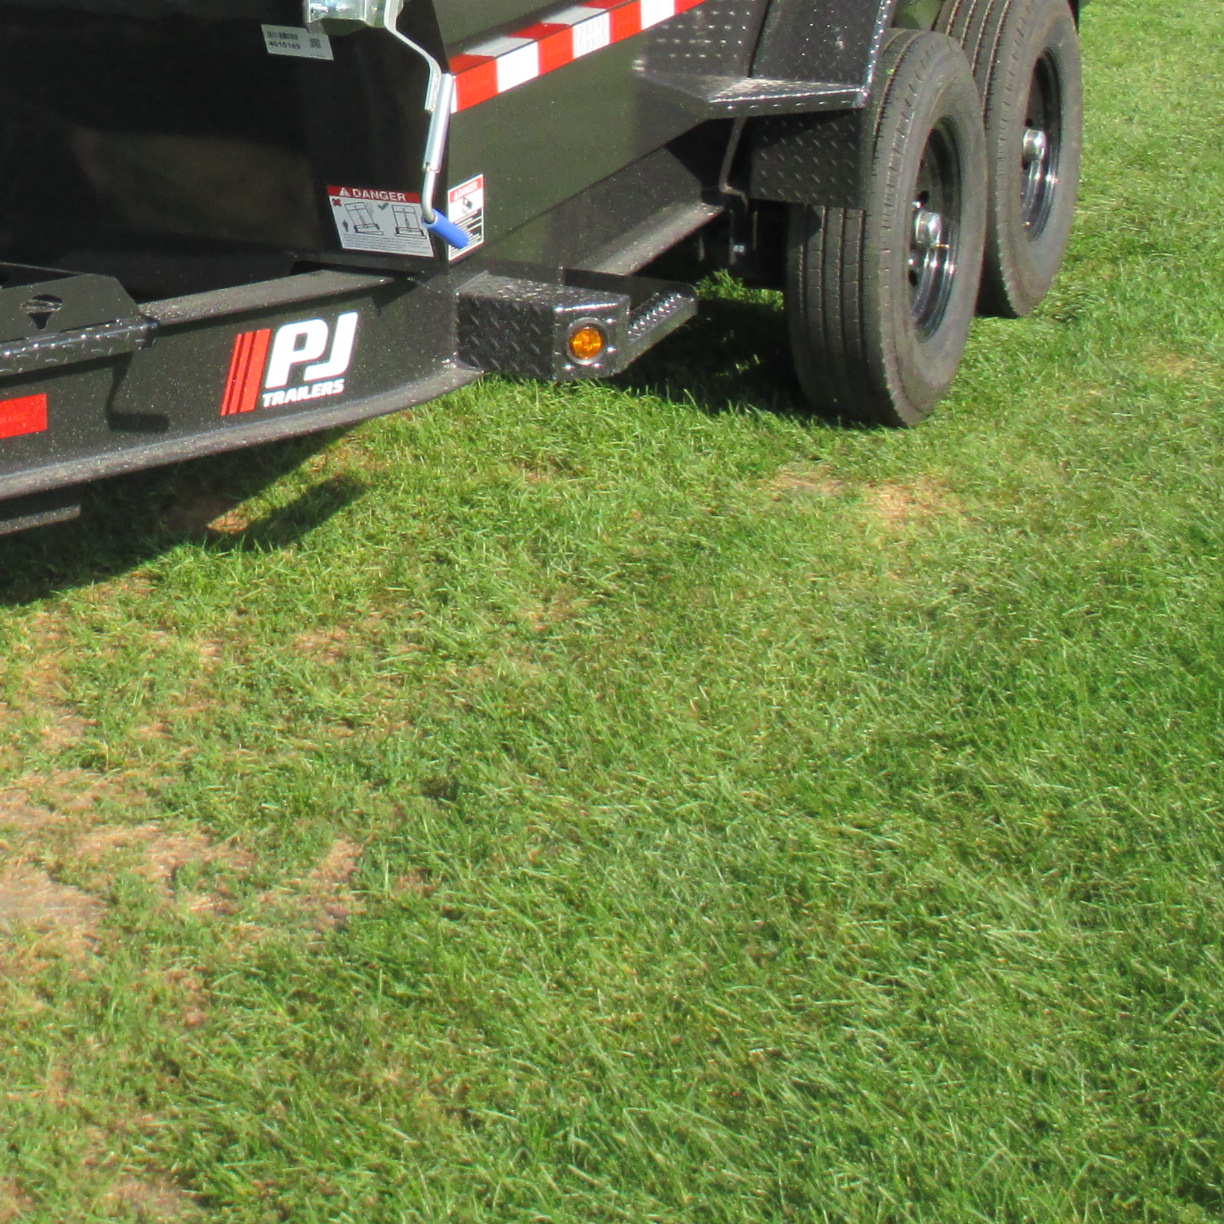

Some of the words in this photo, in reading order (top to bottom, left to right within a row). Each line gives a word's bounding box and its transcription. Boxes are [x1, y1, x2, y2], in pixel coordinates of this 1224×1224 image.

[352, 188, 406, 202] DANGER
[265, 311, 358, 389] PJ
[262, 378, 345, 408] TRAILERS
